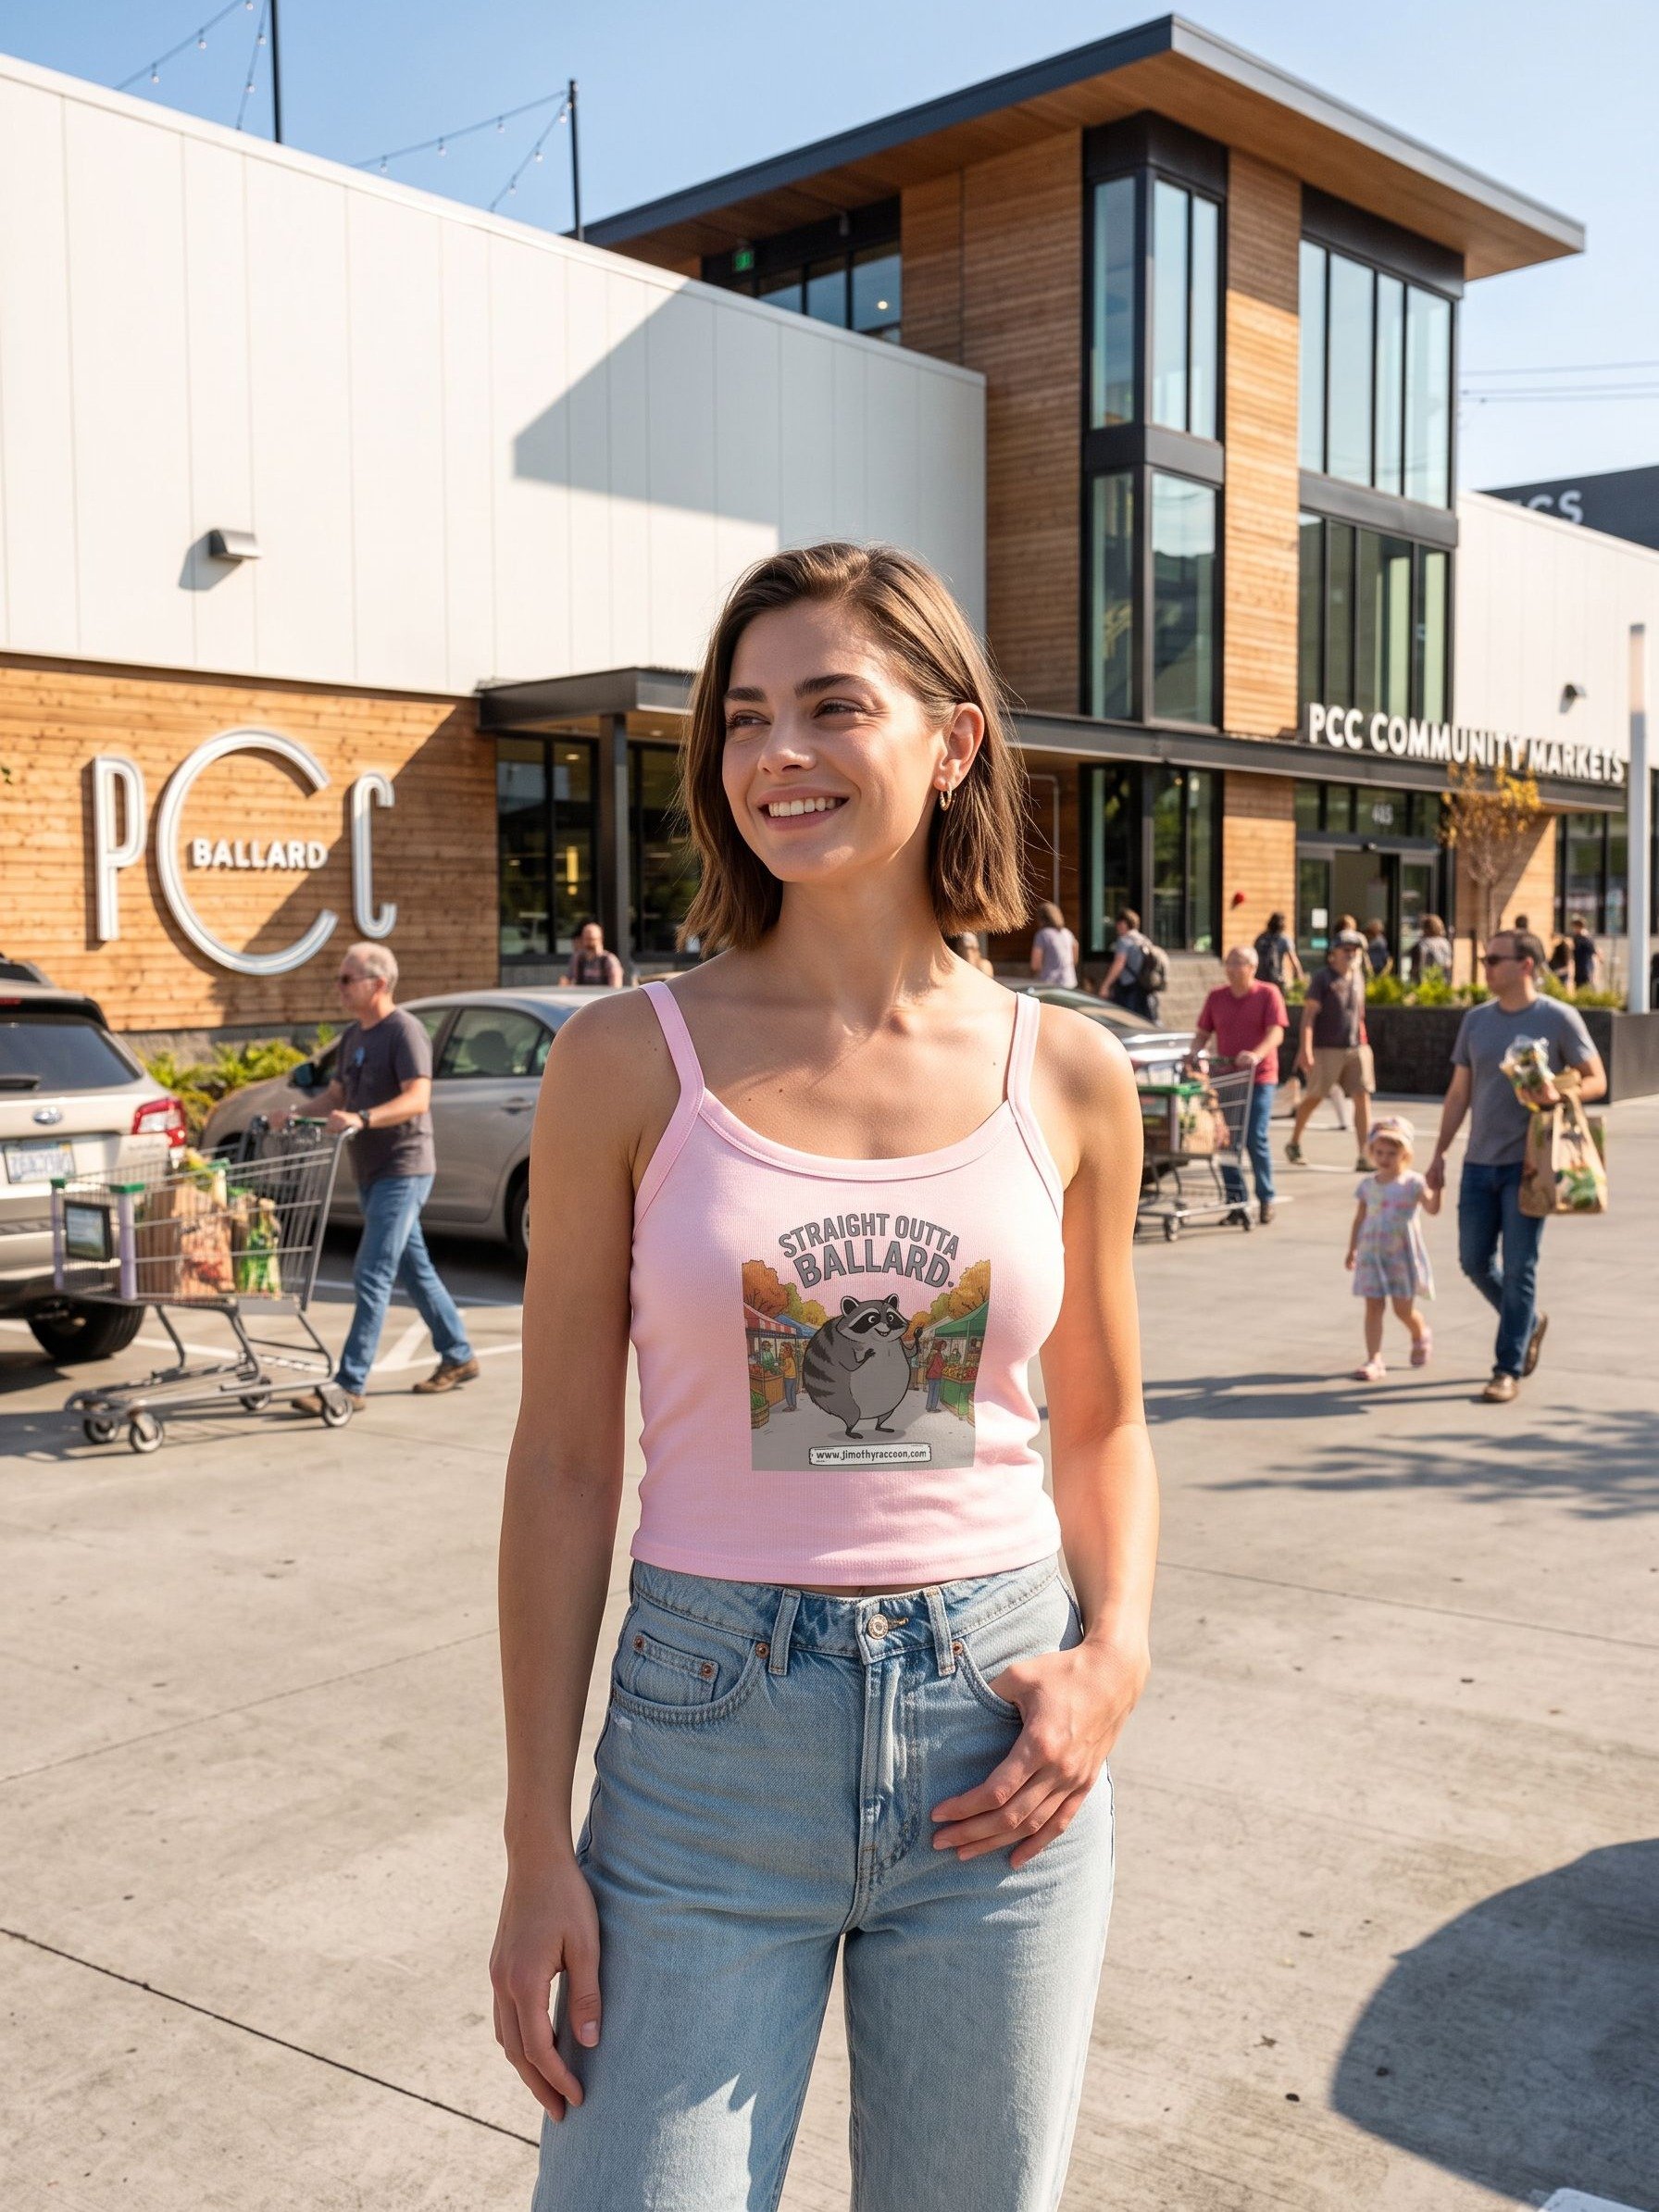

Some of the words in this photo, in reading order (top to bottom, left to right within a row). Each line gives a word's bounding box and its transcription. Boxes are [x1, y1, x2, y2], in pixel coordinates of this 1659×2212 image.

[1309, 702, 1364, 751] PCC
[1369, 712, 1524, 770] COMMUNITY
[1528, 739, 1624, 784] MARKETS
[192, 837, 328, 869] BALLARD
[778, 1213, 890, 1258] STRAIGHT
[894, 1215, 960, 1260] OUTTA
